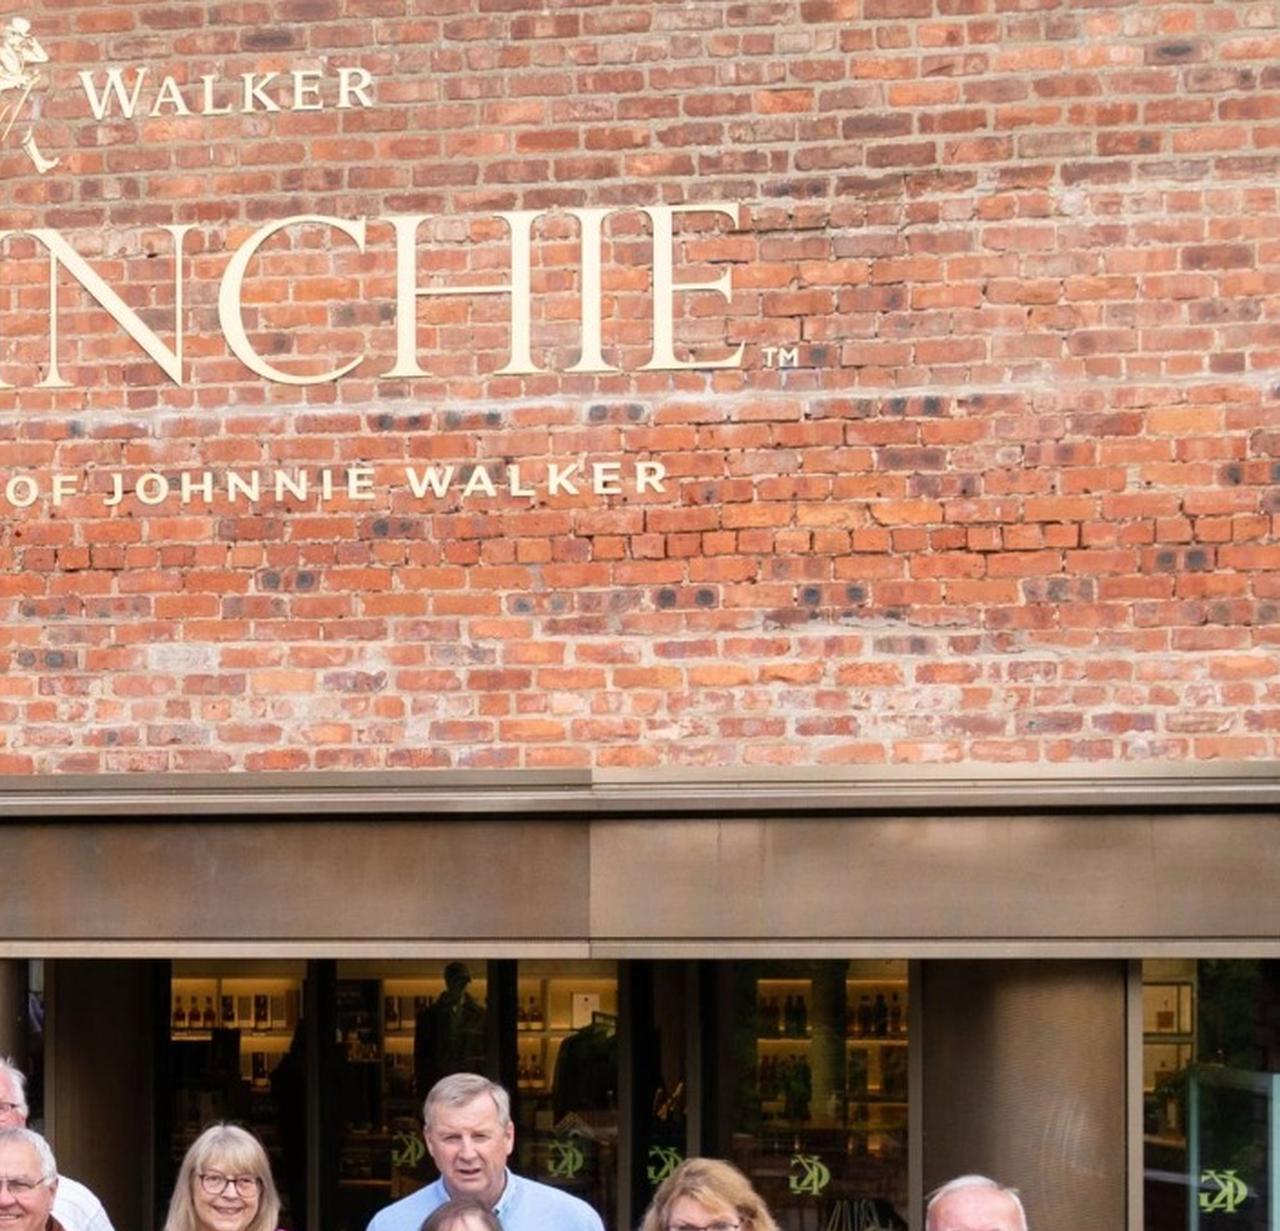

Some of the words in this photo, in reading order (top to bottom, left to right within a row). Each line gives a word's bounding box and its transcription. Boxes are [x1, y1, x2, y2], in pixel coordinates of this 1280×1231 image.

[79, 65, 378, 122] WALKER
[23, 473, 79, 508] OF
[104, 466, 377, 507] JOHNNIE
[405, 460, 669, 500] WALKER
